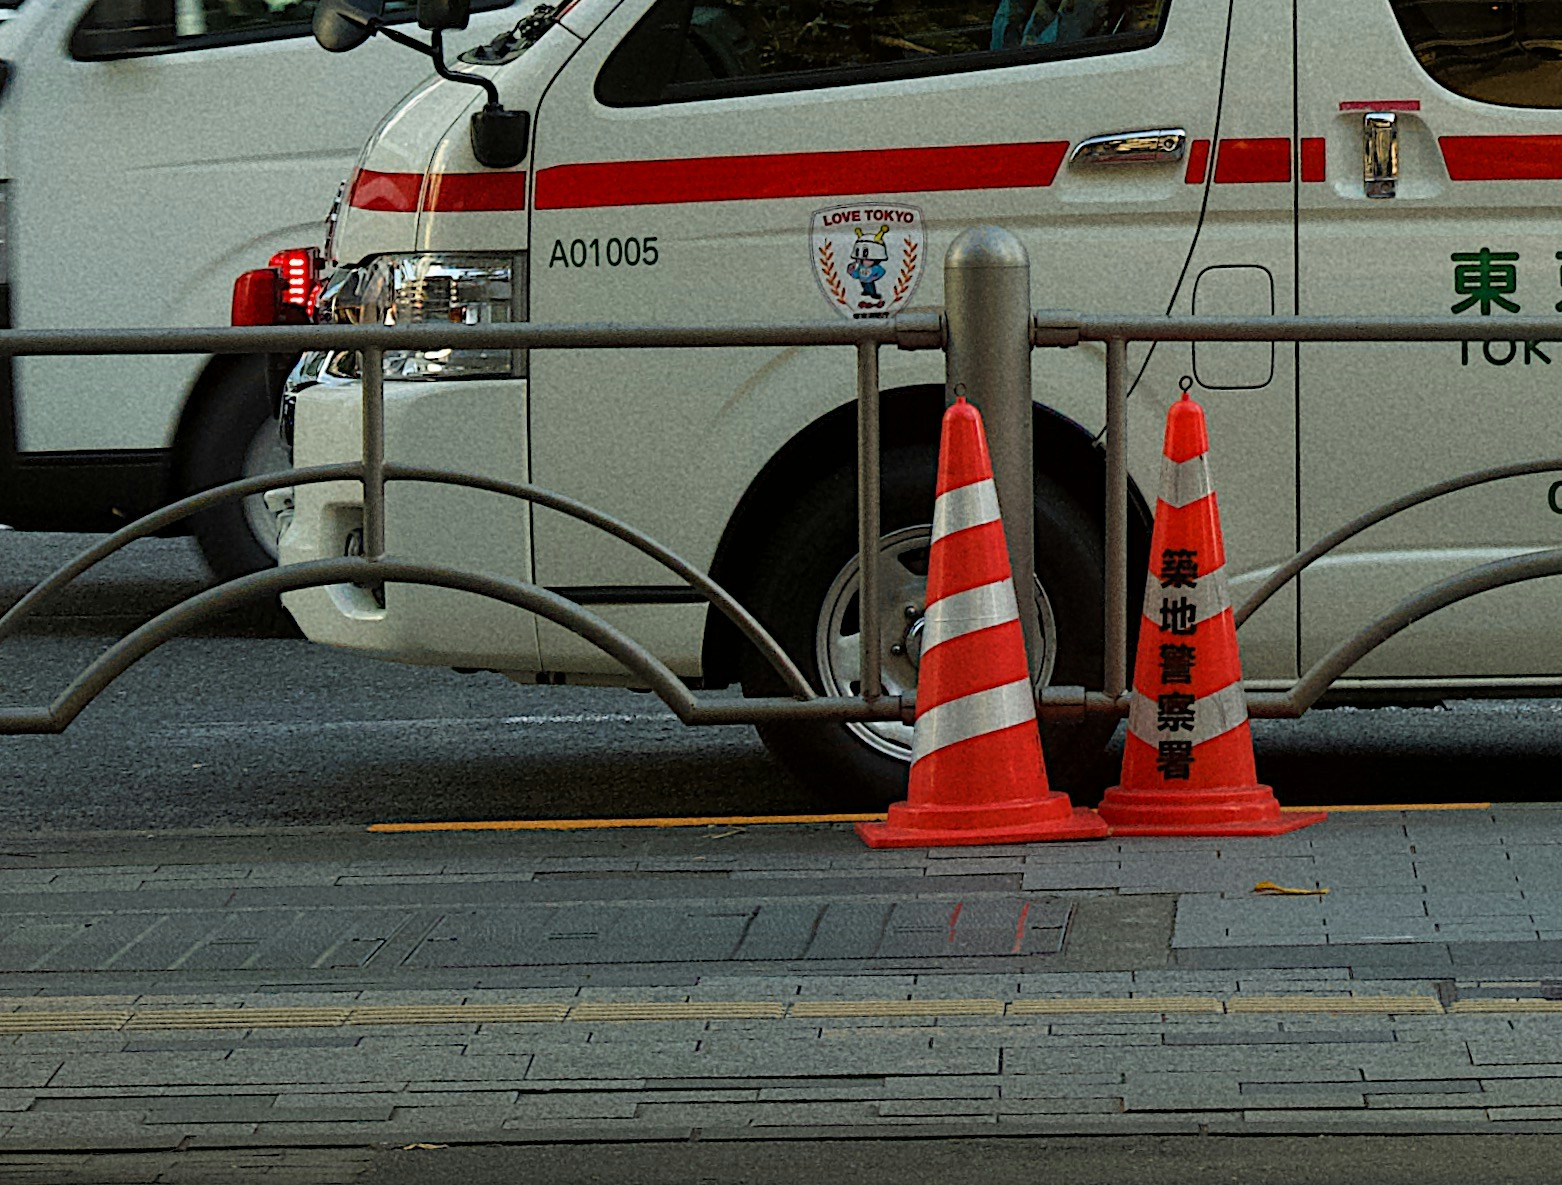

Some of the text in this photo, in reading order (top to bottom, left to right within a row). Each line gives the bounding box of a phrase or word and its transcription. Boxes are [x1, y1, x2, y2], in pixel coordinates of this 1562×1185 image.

[823, 210, 914, 226] LOVE TOKYO
[549, 236, 659, 268] A01005
[1156, 548, 1198, 781] 築地警察署
